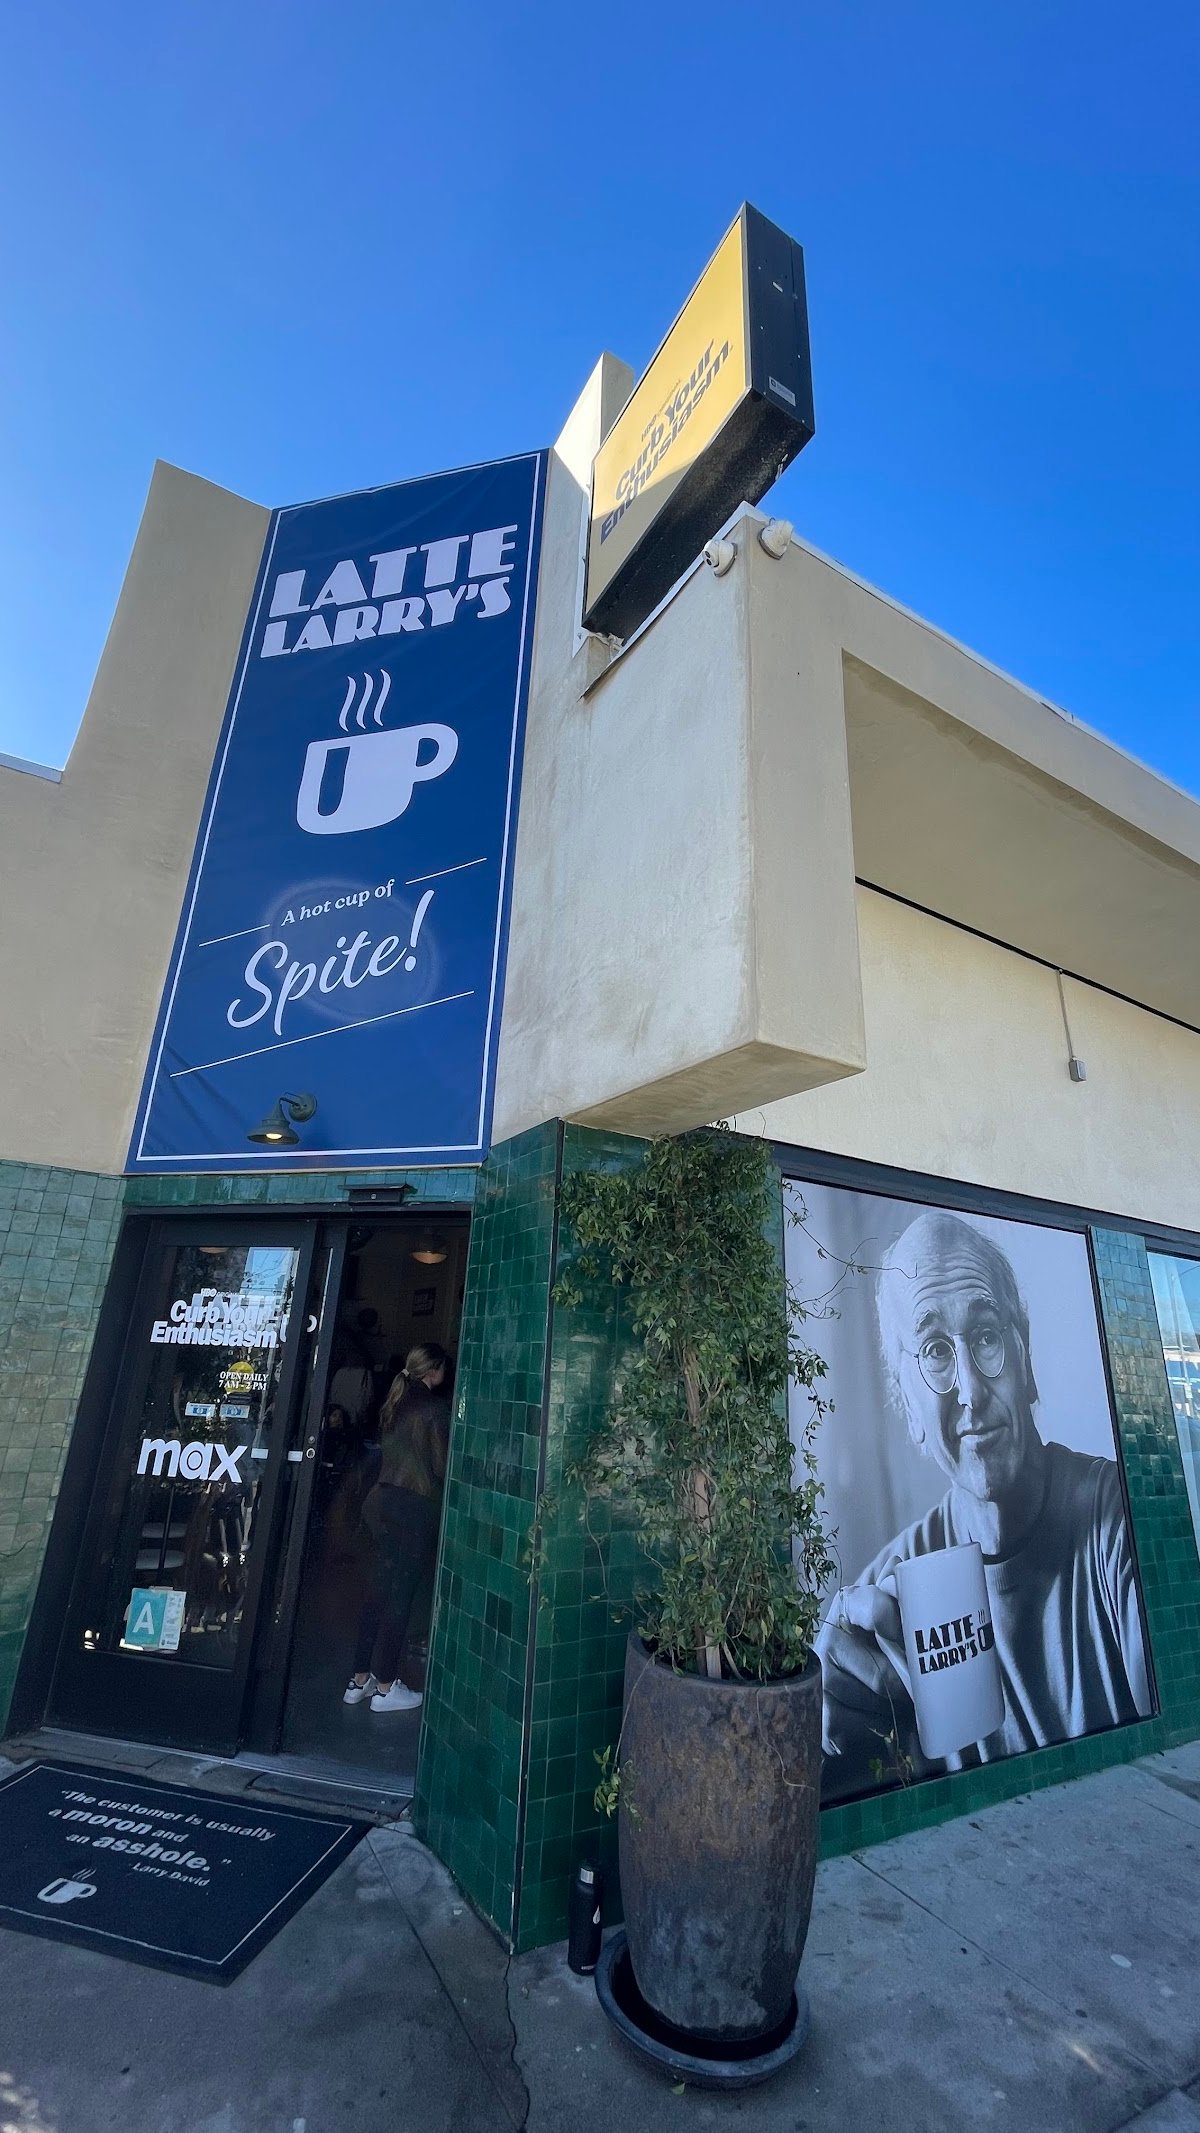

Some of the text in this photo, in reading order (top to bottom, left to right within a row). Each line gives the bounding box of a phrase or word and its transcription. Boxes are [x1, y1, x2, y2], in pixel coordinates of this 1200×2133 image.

[616, 423, 664, 501] Curb
[664, 338, 714, 426] Your
[269, 524, 518, 618] LATTE
[260, 576, 511, 658] LARRY'S
[281, 879, 395, 926] A hot cup of
[226, 889, 435, 1036] Spite!
[200, 1287, 217, 1298] HBO
[170, 1300, 272, 1326] Curb Your
[218, 1380, 223, 1388] 7
[223, 1380, 239, 1389] AM
[245, 1382, 251, 1390] 2
[252, 1382, 267, 1391] PM
[220, 1371, 269, 1382] OPEN DAILY
[136, 1438, 248, 1484] max
[132, 1601, 155, 1635] A
[914, 1613, 975, 1654] LATTE
[918, 1639, 978, 1675] LARRY'S
[48, 1808, 189, 1843] a moron and
[65, 1833, 90, 1844] an
[97, 1799, 185, 1821] customer
[185, 1813, 203, 1826] is
[205, 1821, 276, 1842] usually
[132, 1862, 210, 1887] Larry David
